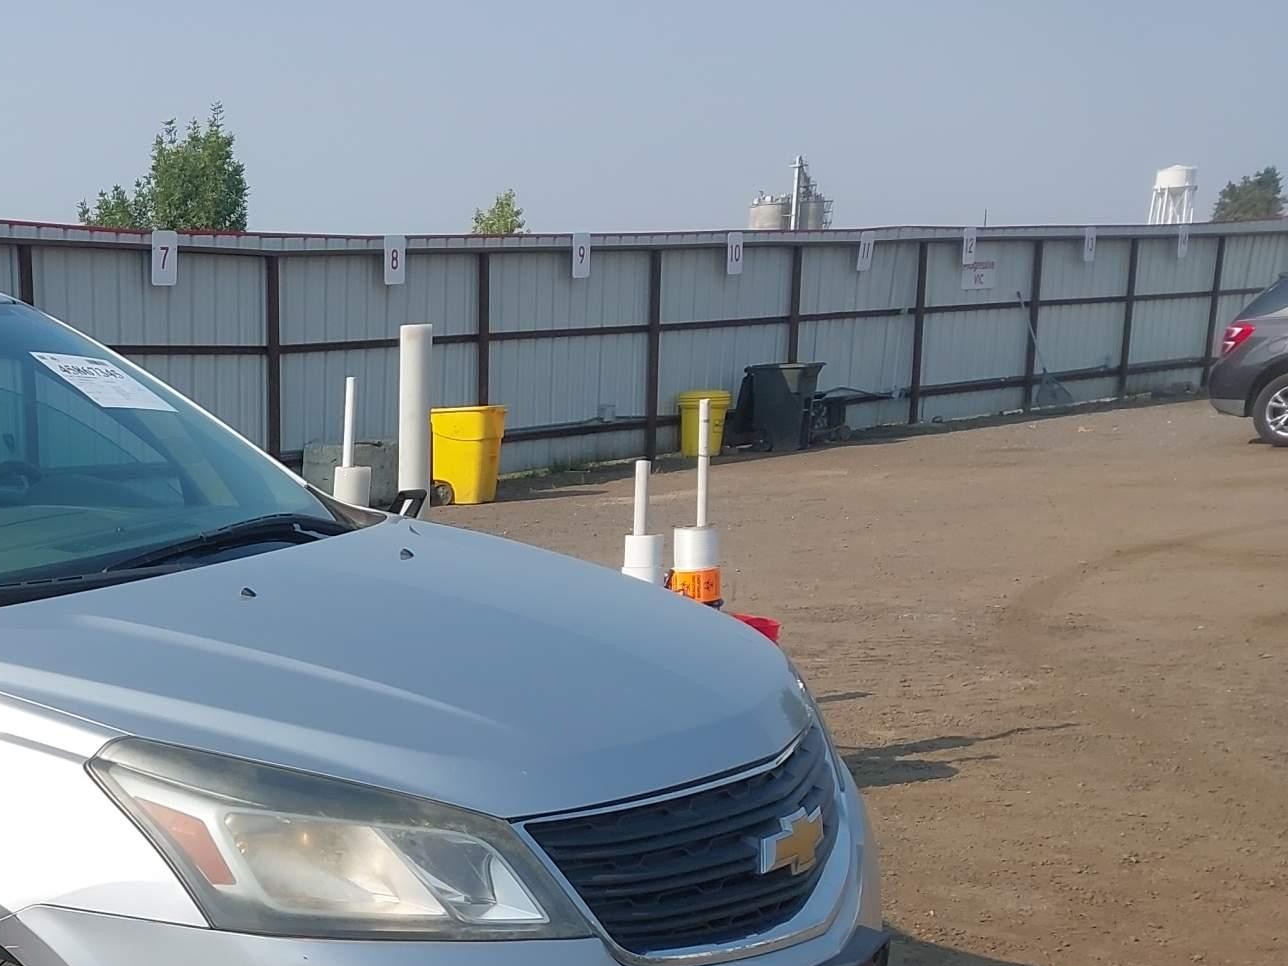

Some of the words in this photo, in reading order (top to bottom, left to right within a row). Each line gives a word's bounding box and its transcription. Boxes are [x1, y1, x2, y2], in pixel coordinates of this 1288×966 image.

[159, 246, 169, 270] 7
[579, 246, 585, 264] 9
[730, 244, 741, 262] 10
[861, 241, 870, 259] 11
[391, 249, 399, 270] 8
